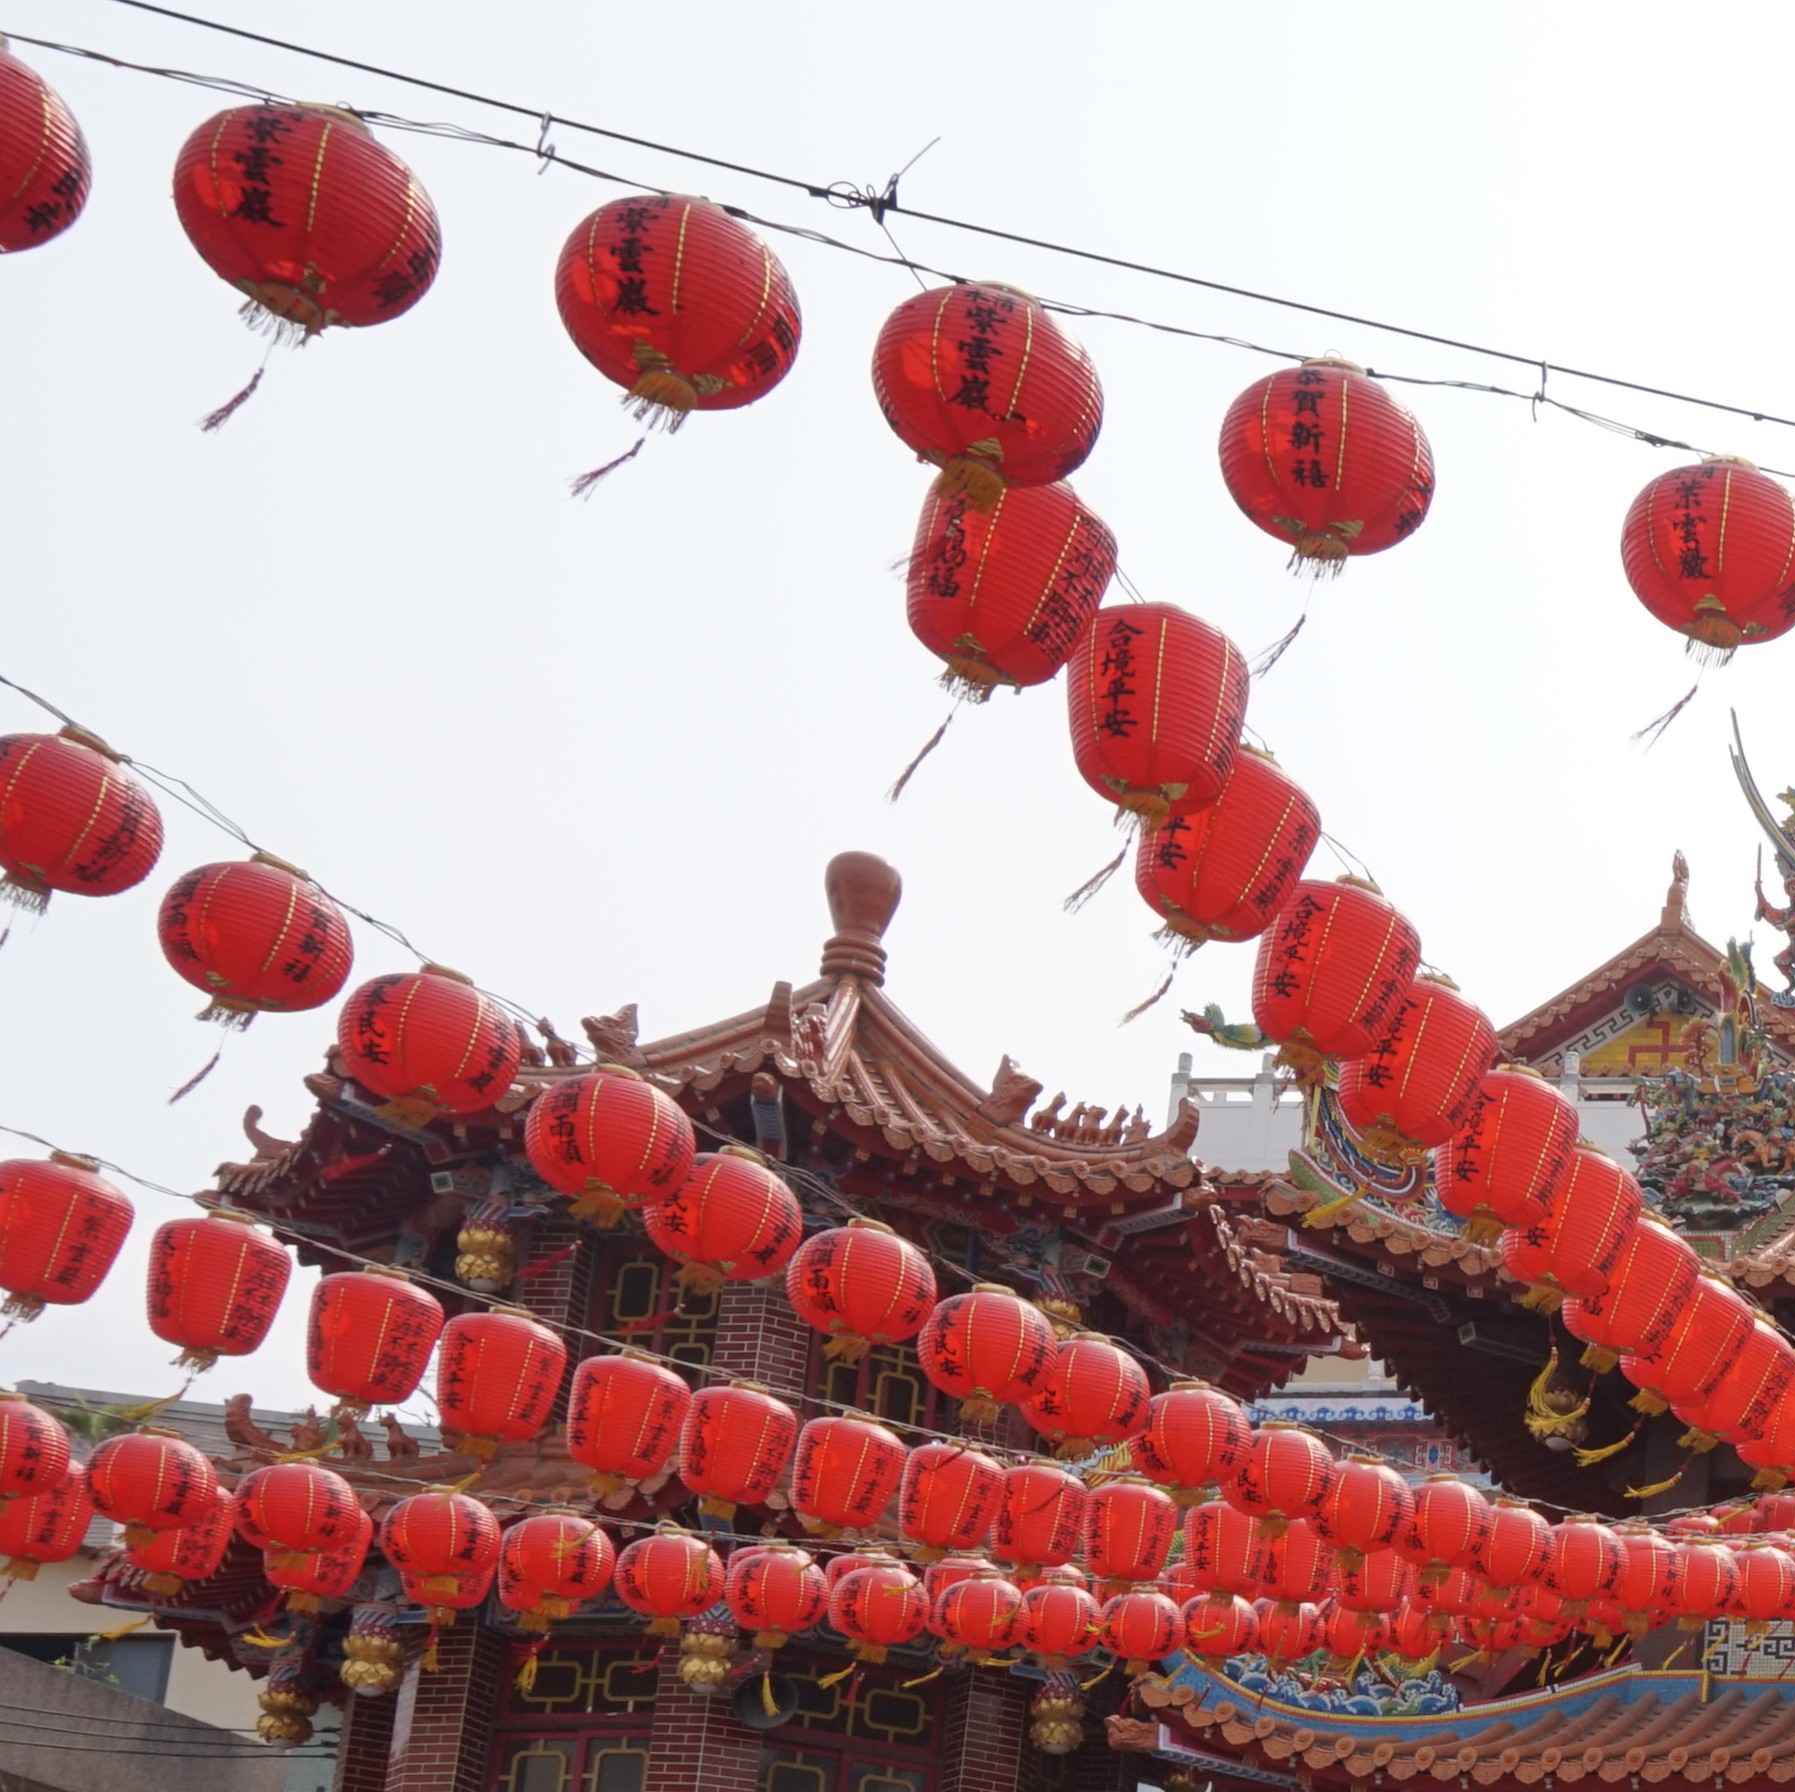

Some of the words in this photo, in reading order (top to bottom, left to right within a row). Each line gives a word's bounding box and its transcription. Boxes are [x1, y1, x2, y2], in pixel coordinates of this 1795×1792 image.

[230, 115, 290, 228] 紫雲巖
[610, 207, 662, 317] 紫雲巖
[948, 304, 1012, 415] 紫雲巖
[1291, 370, 1329, 489] 恭賀新禧
[1673, 480, 1710, 580] 紫雲巖
[1097, 619, 1143, 738] 合境平安
[1268, 893, 1324, 998] 合境平安
